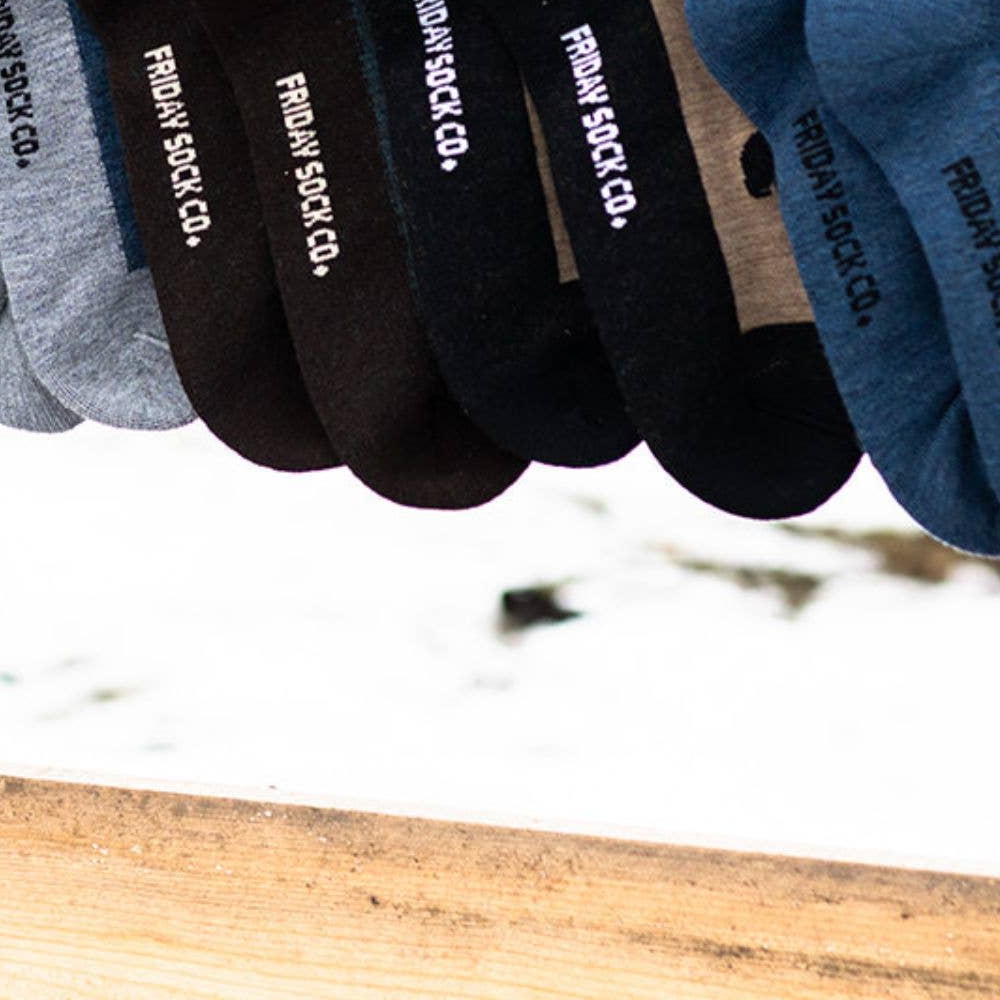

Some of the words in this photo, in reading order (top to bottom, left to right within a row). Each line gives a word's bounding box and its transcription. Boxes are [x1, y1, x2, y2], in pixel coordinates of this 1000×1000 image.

[1, 59, 35, 124] SOCK
[143, 44, 190, 130] FRIDAY
[424, 52, 464, 120] SOCK
[559, 23, 610, 106] FRIDAY
[10, 125, 40, 169] CO.
[275, 71, 322, 158] FRIDAY
[433, 119, 470, 172] CO.
[581, 107, 629, 178] SOCK
[163, 131, 203, 200] SOCK
[295, 160, 334, 228] SOCK
[178, 198, 212, 248] CO.
[600, 176, 637, 230] CO.
[792, 108, 844, 200] FRIDAY
[821, 202, 869, 278] SOCK
[845, 273, 881, 327] CO.
[306, 228, 340, 278] CO.
